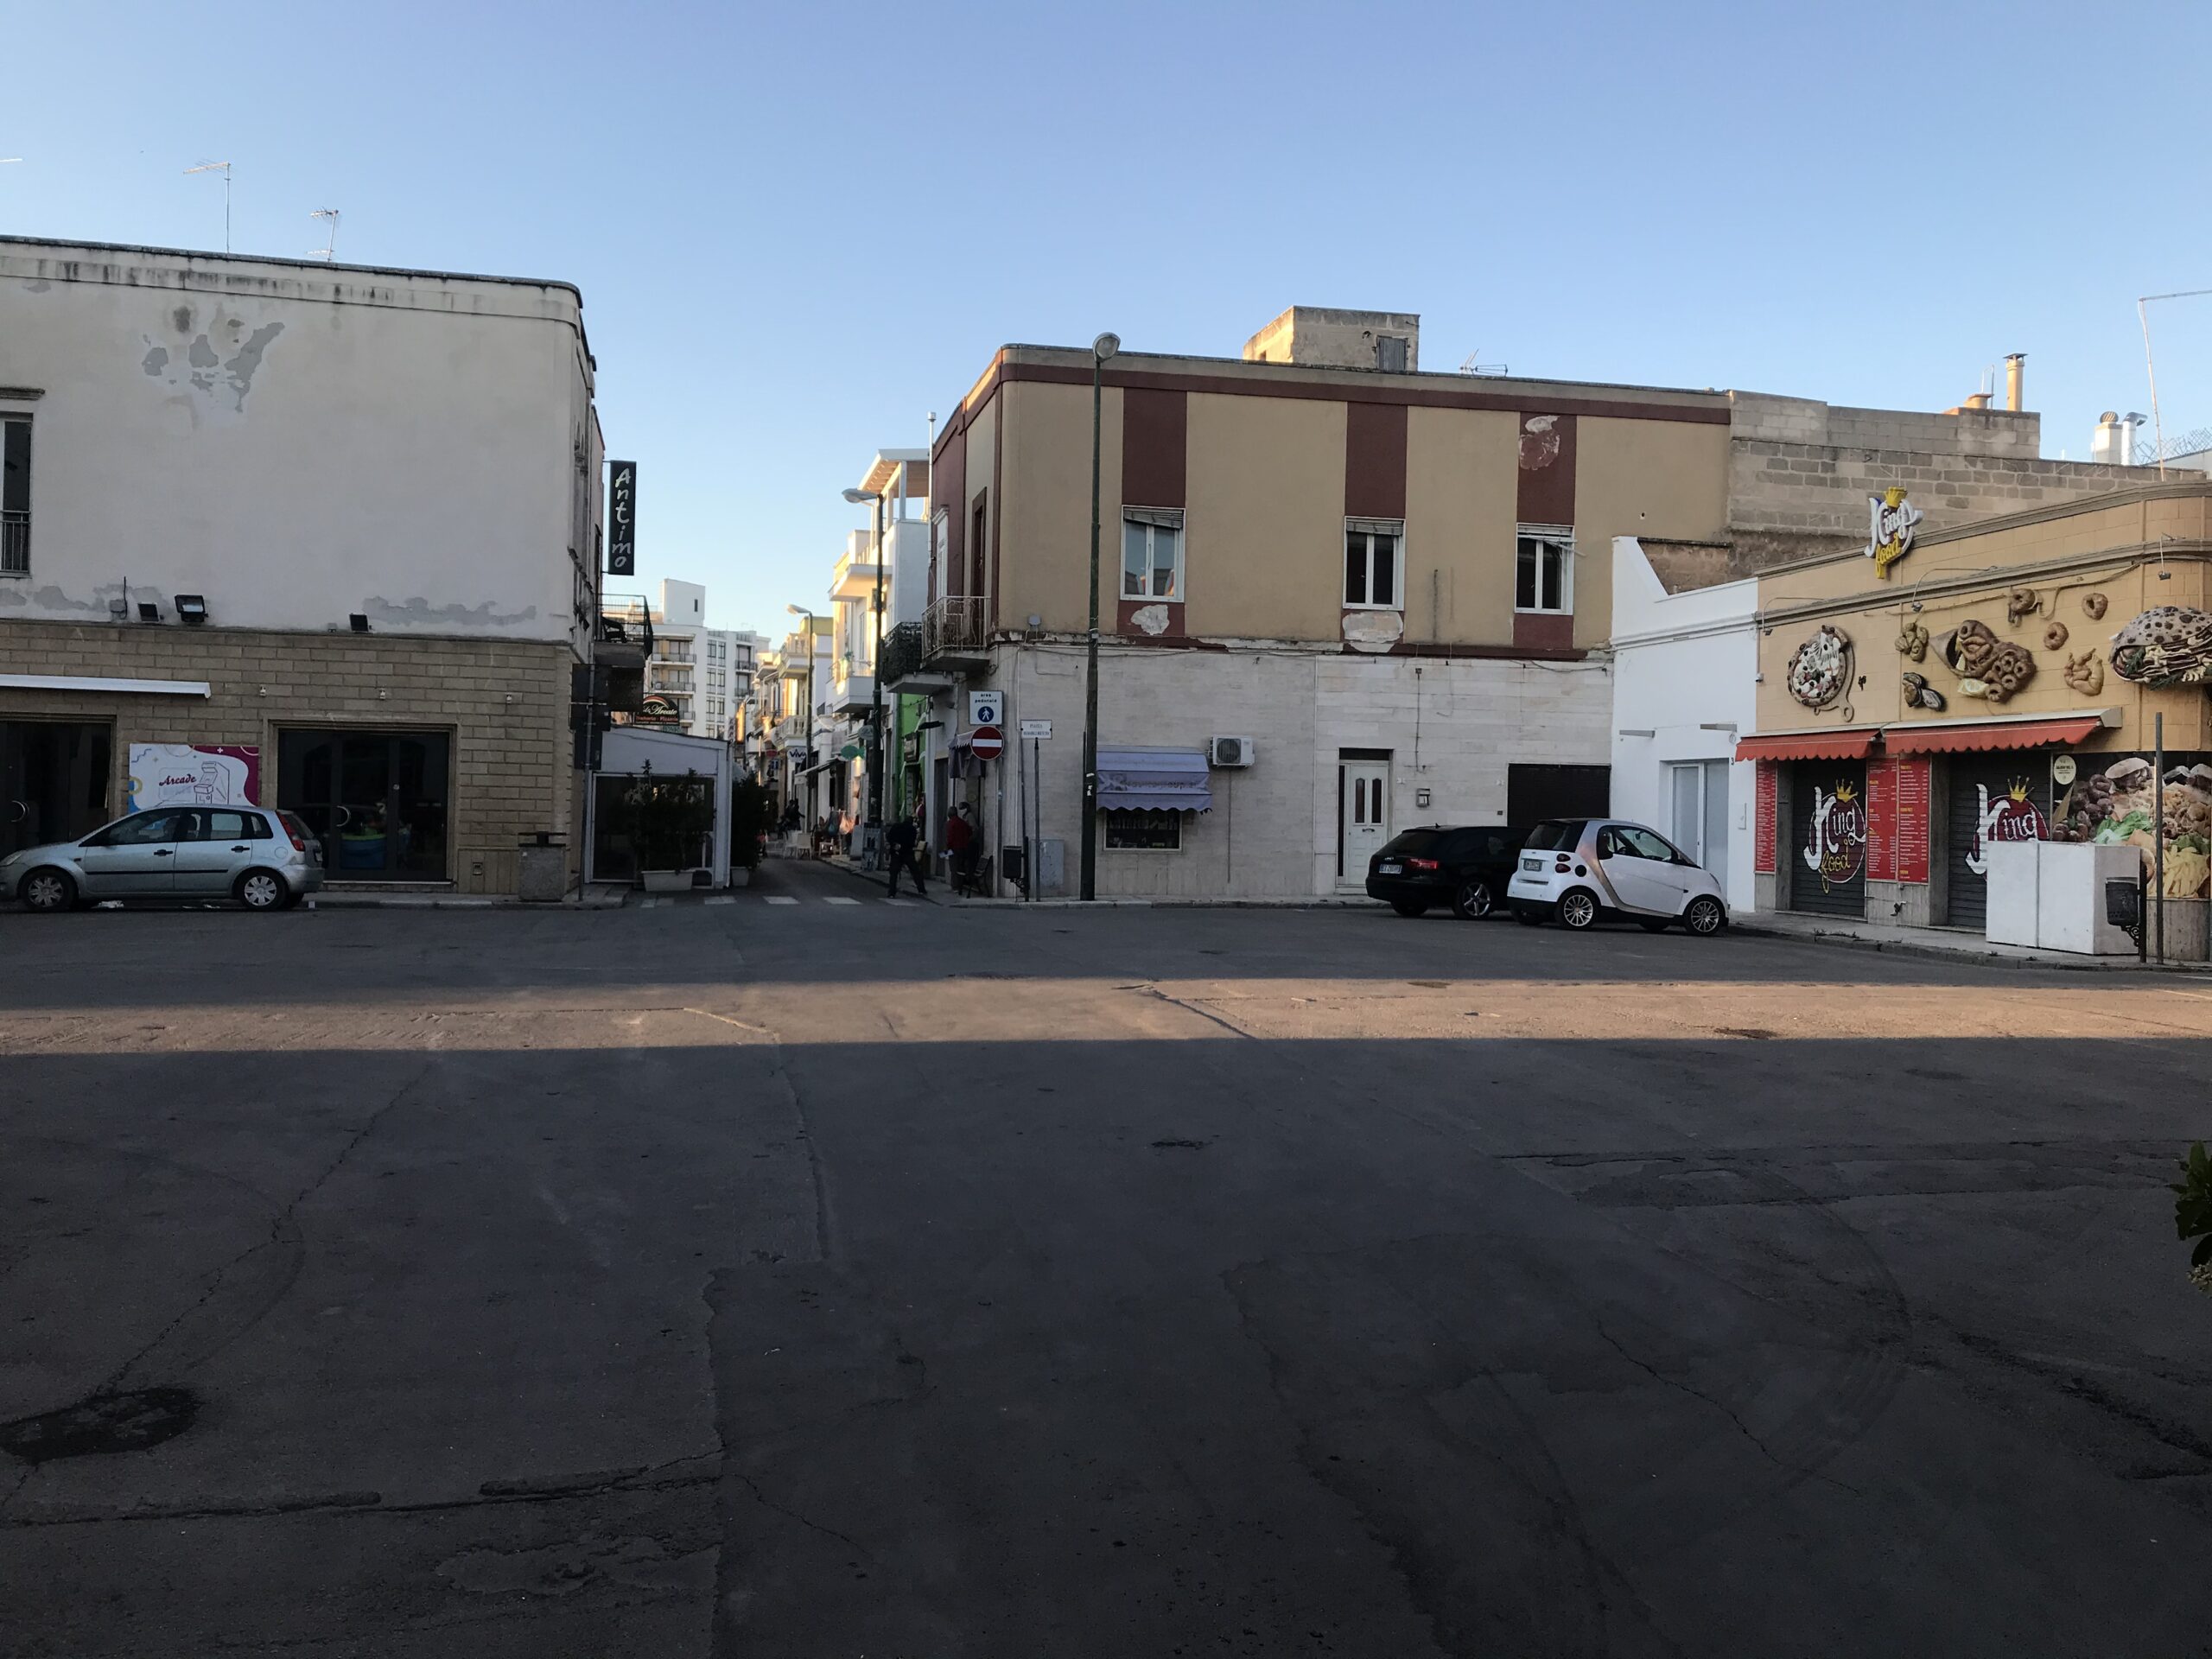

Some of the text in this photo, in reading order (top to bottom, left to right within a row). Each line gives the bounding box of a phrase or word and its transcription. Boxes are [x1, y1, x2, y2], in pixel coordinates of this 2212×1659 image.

[612, 467, 632, 568] Antimo
[1865, 498, 1923, 557] King
[1876, 532, 1903, 579] food
[159, 773, 198, 786] Arcade
[1803, 786, 1866, 871] King
[1821, 838, 1851, 894] food
